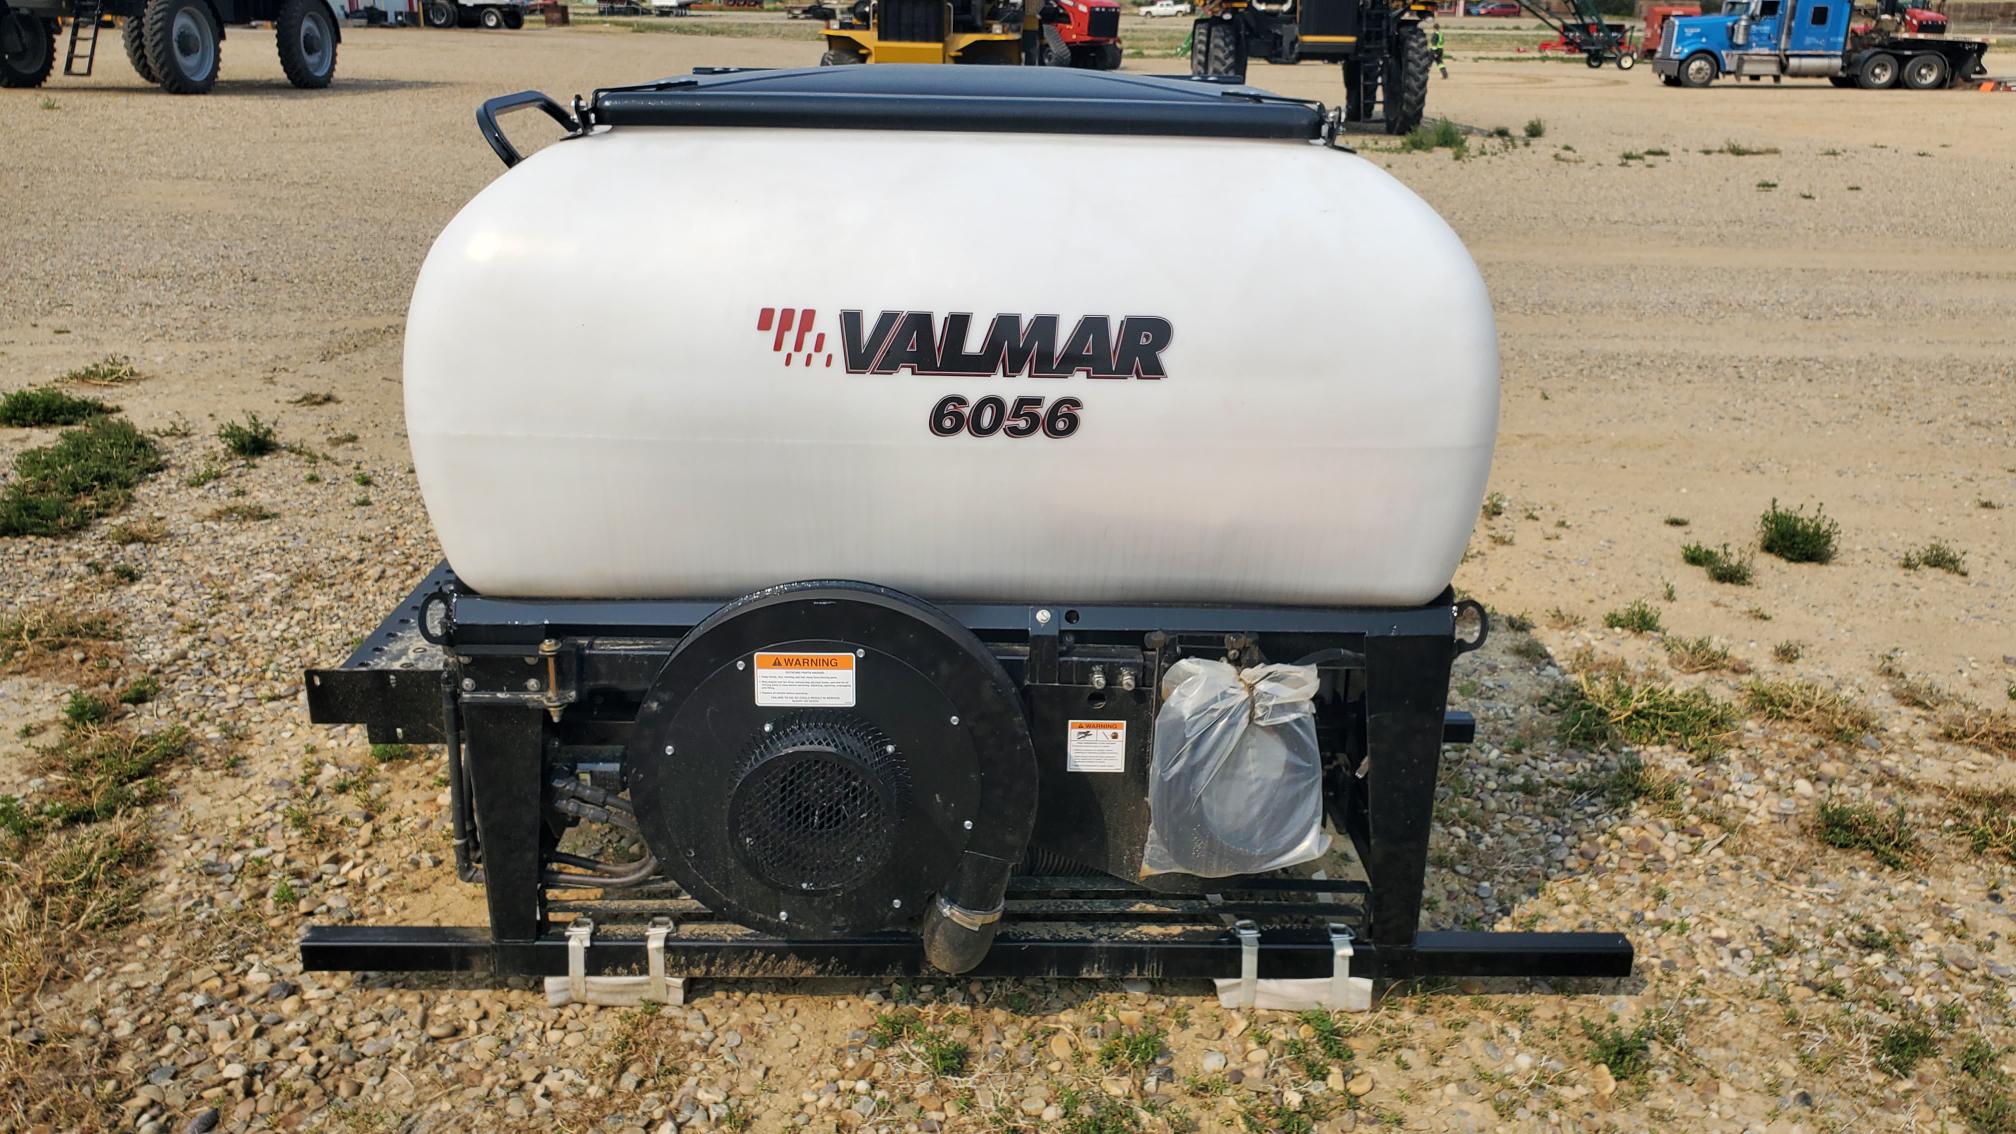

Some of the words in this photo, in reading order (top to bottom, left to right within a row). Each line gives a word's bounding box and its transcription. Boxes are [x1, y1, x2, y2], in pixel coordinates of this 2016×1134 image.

[839, 309, 1173, 380] VALMAR
[929, 394, 1083, 439] 6056
[784, 658, 838, 667] WARNING
